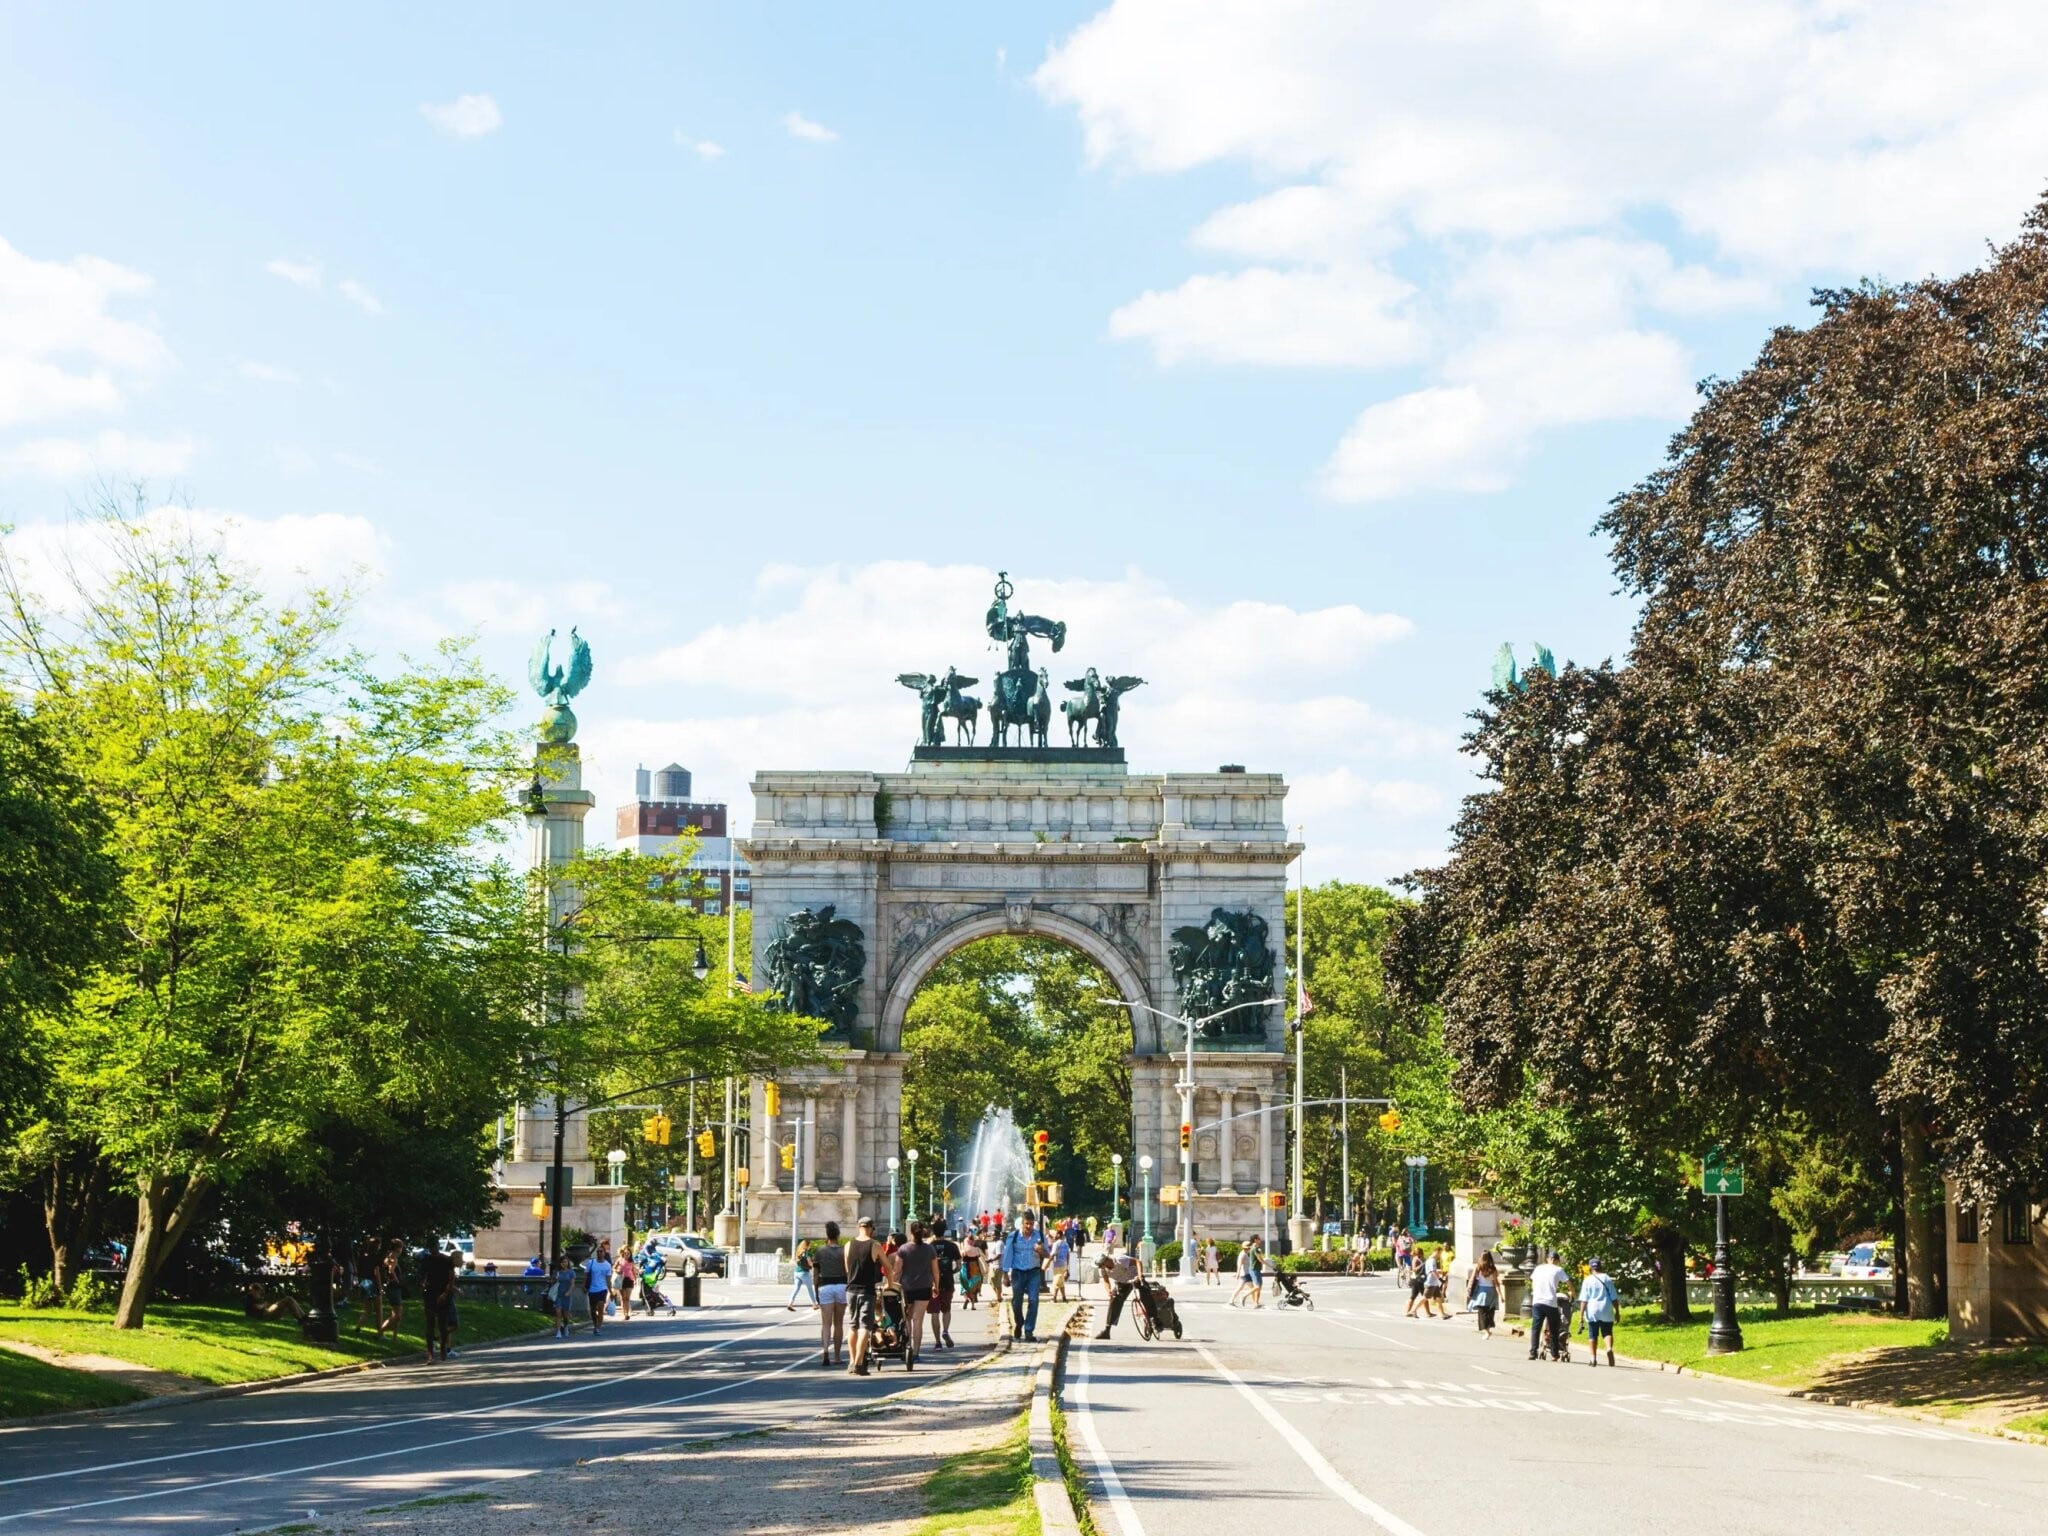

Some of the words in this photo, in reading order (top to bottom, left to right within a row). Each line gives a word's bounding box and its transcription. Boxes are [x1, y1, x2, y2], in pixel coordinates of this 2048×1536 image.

[918, 871, 937, 883] THE
[941, 871, 1008, 883] DEFENDERS
[1012, 872, 1026, 883] OF
[1268, 1390, 1601, 1415] SCHOOL
